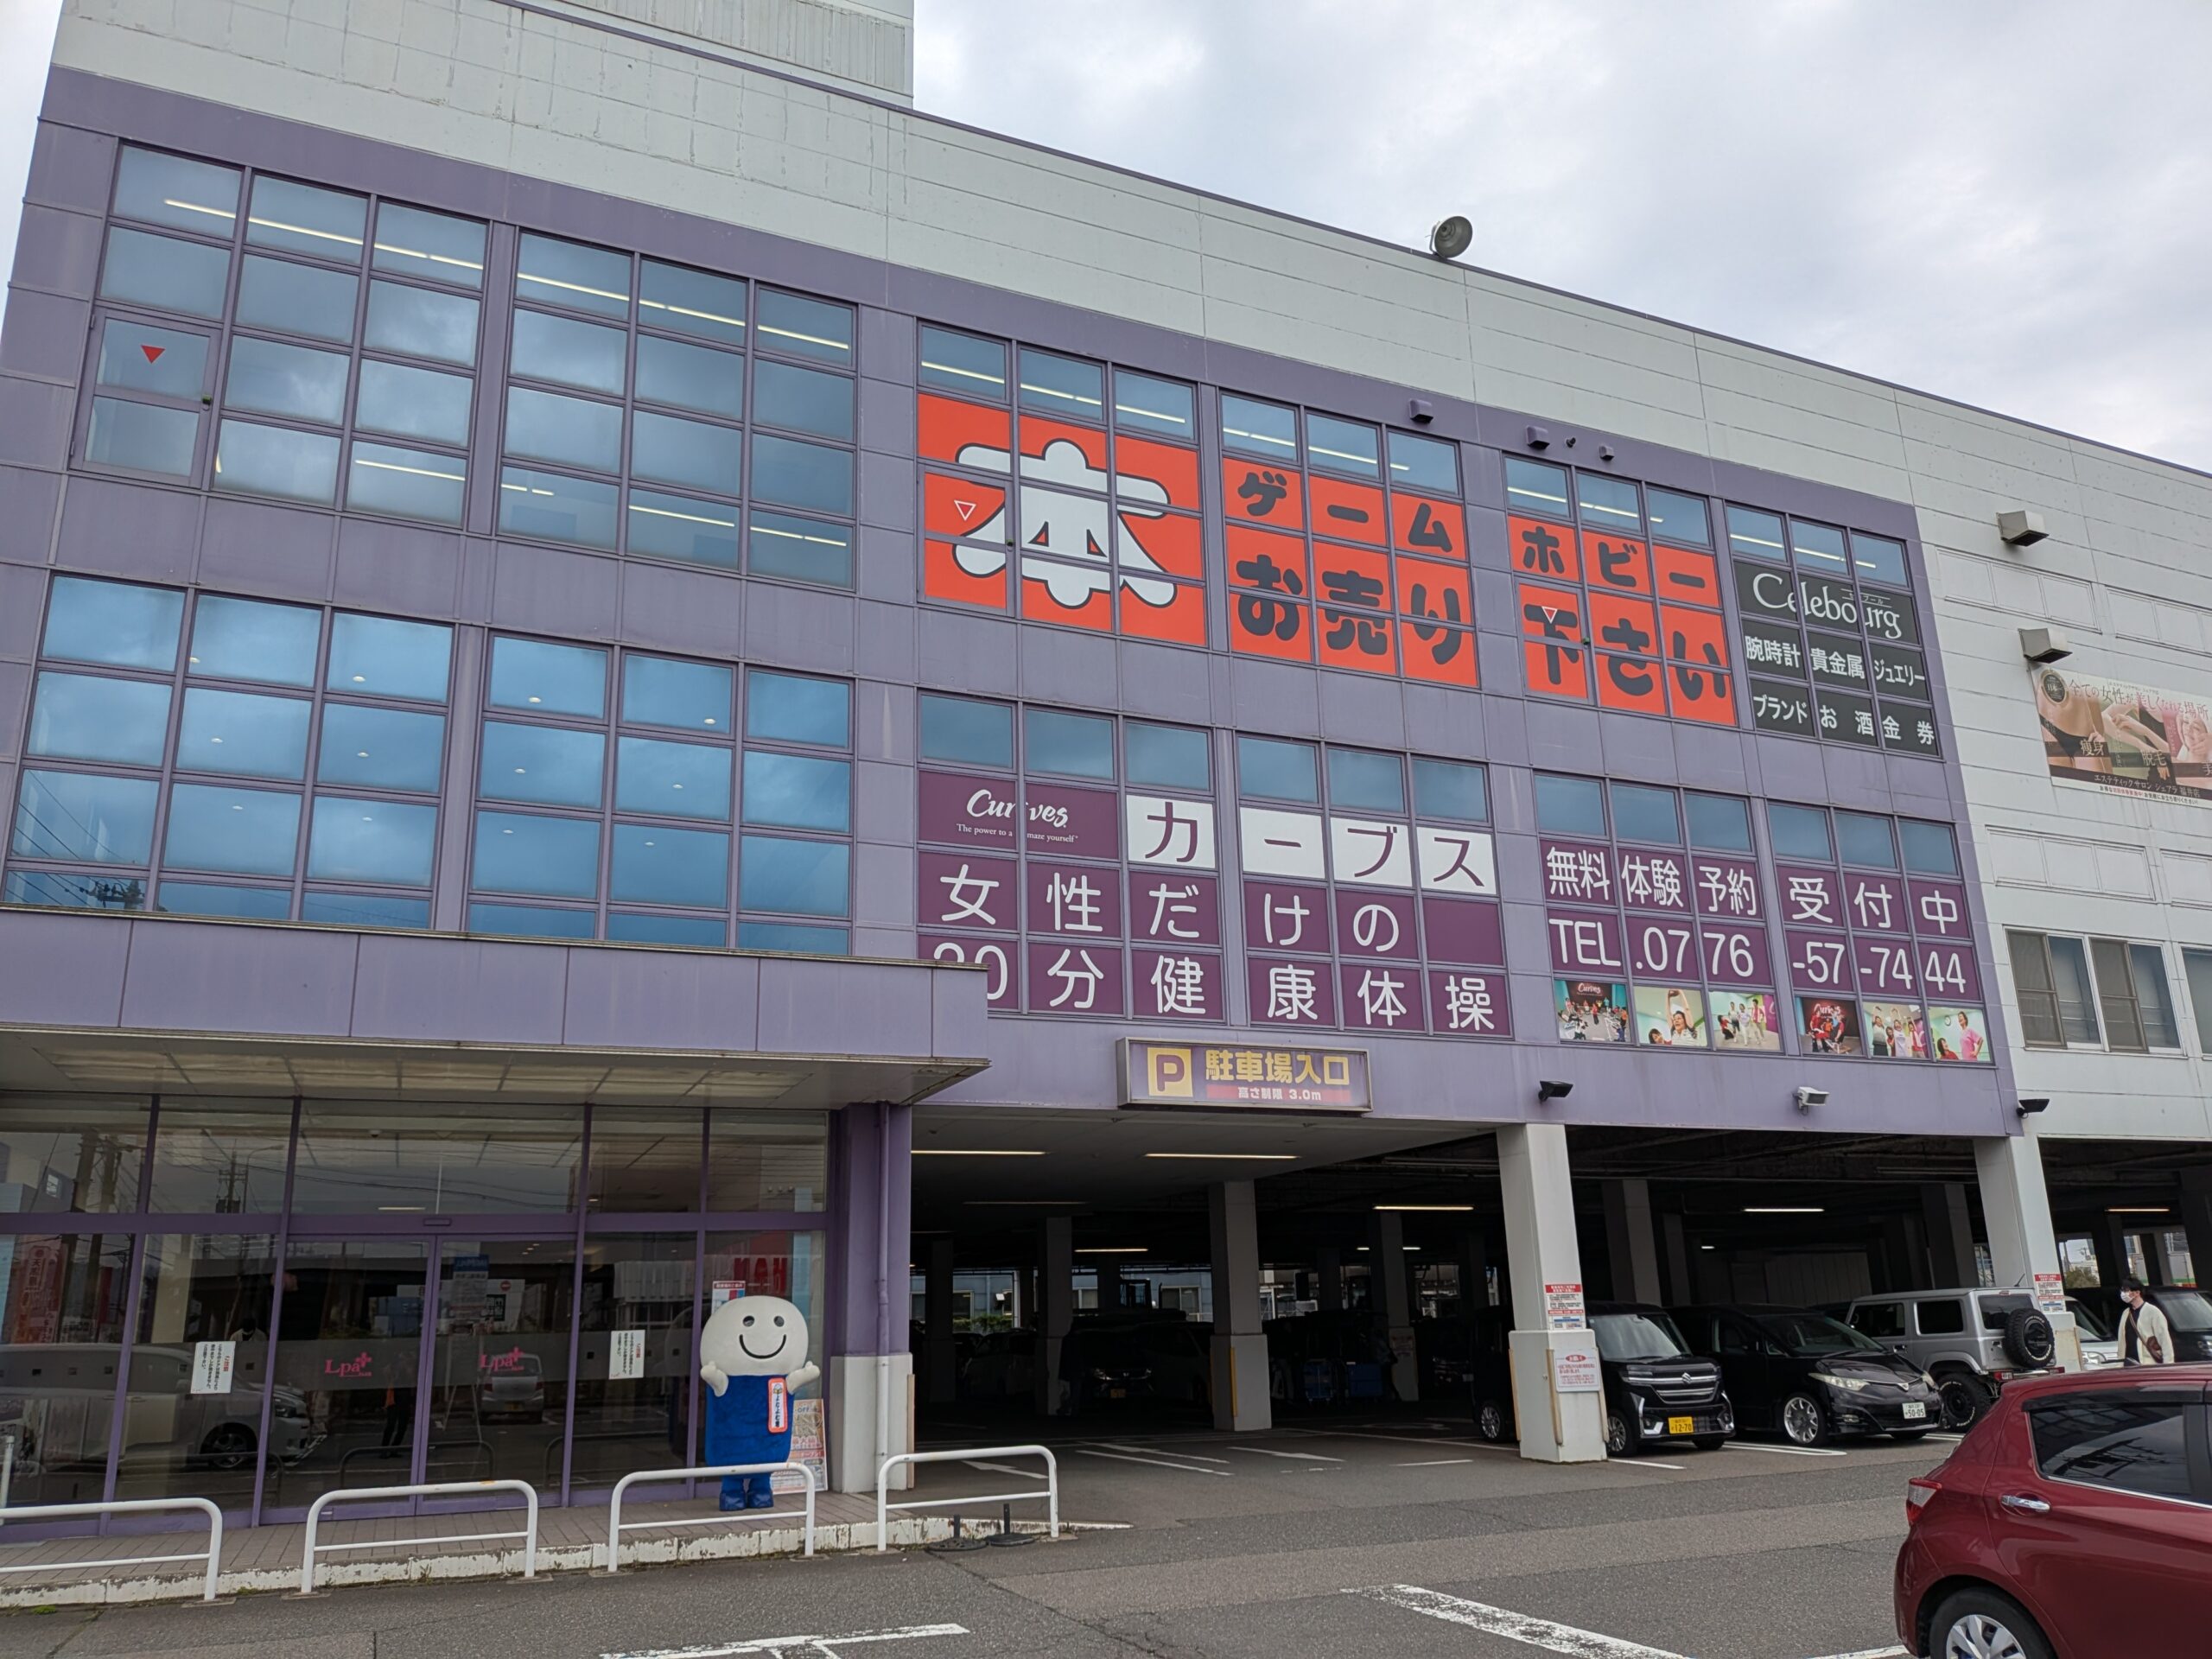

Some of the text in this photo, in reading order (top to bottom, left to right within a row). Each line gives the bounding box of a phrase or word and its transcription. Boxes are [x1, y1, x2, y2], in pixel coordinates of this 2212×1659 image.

[954, 438, 1178, 607] 本
[1237, 471, 1706, 588] ゲーム ホビー
[1236, 554, 1726, 702] お売り 下さい
[1752, 573, 1902, 639] Celebourg
[1745, 635, 1925, 686] 腕時計 貴金属 ジュエリー
[1753, 695, 1808, 724] ブランド
[966, 789, 1069, 828] Curves
[974, 827, 996, 836] power
[1144, 800, 1484, 887] カーブス
[939, 864, 1400, 952] 女性だけの
[933, 942, 1495, 1031] 0分健康体操
[1156, 1054, 1185, 1092] P
[1205, 1049, 1350, 1085] 駐車場入口
[1238, 1086, 1321, 1101] 高さ制限 3.0m
